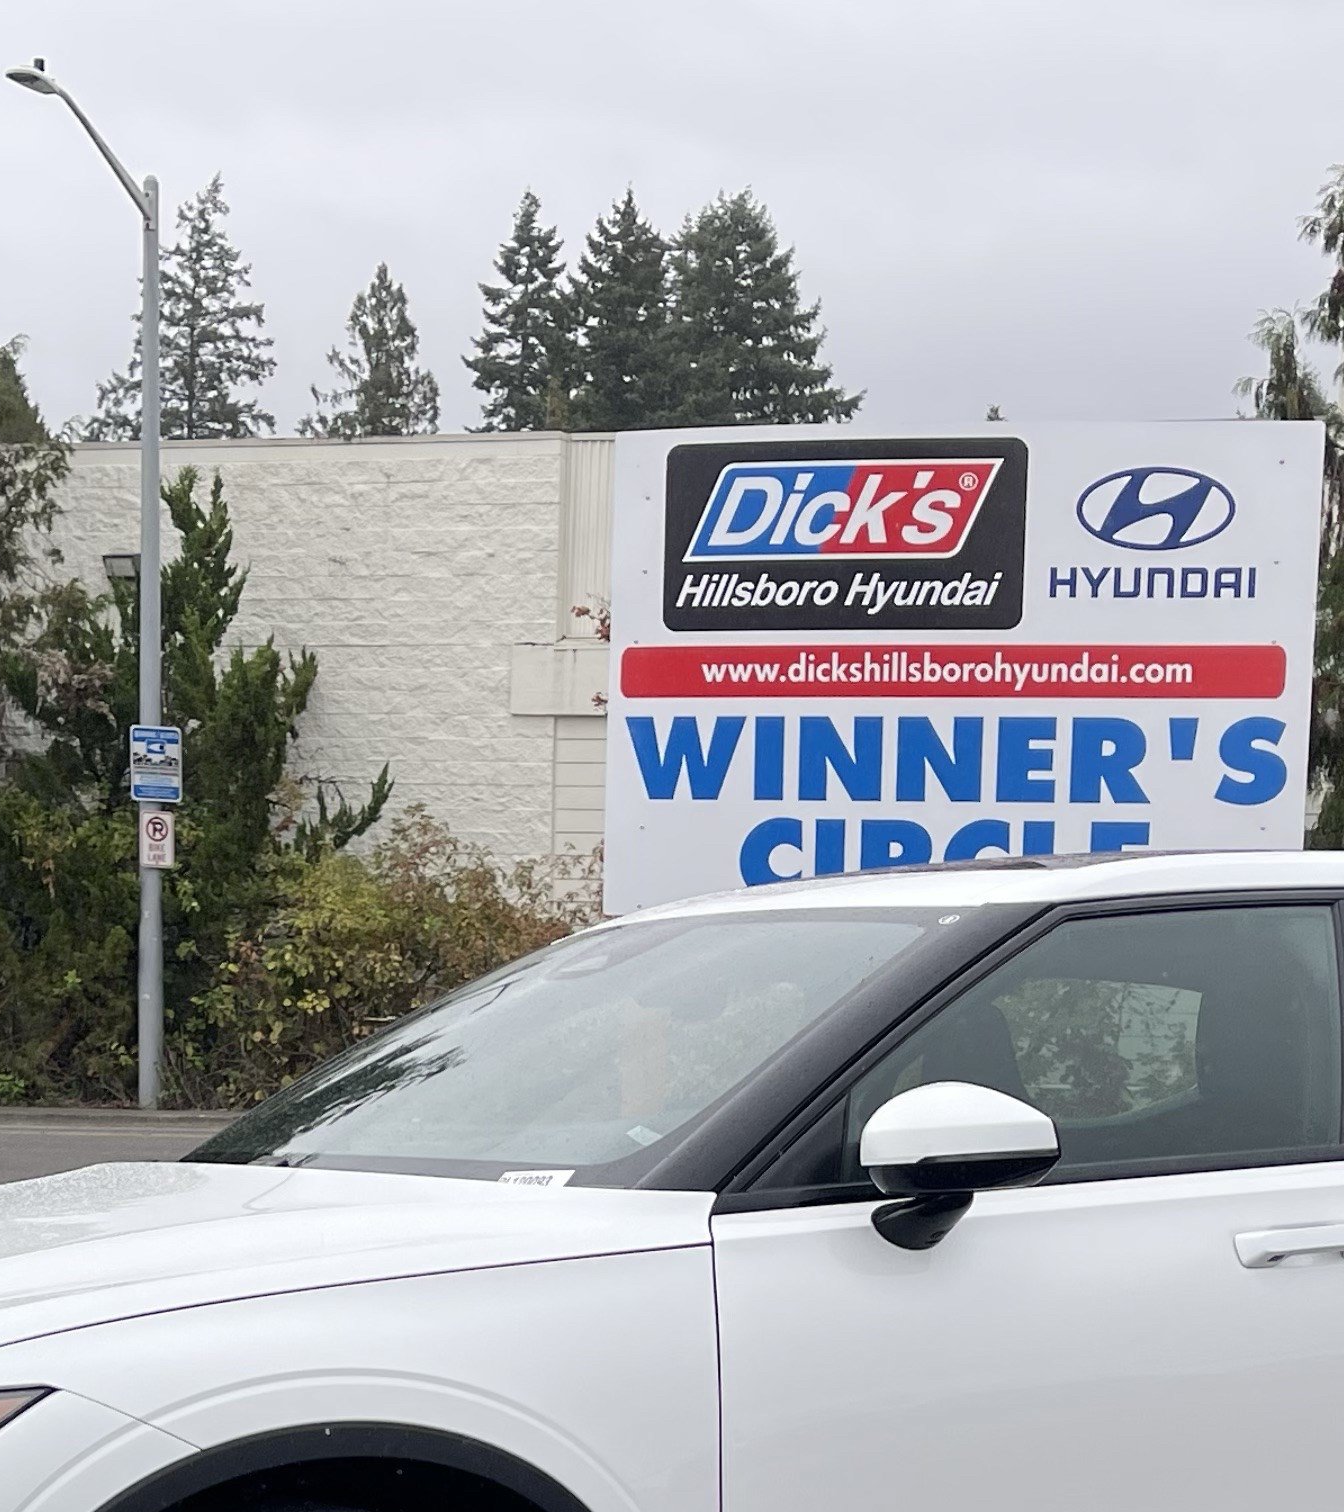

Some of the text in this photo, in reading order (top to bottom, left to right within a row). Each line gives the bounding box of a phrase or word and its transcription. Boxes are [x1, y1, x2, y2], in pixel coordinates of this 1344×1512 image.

[707, 471, 962, 547] Dick's
[675, 572, 1004, 615] Hillsboro Hyundai
[1049, 565, 1256, 599] HYUNDAI
[701, 651, 1193, 691] www.dickshillsborohyundai.com
[626, 715, 1288, 805] WINNER'S
